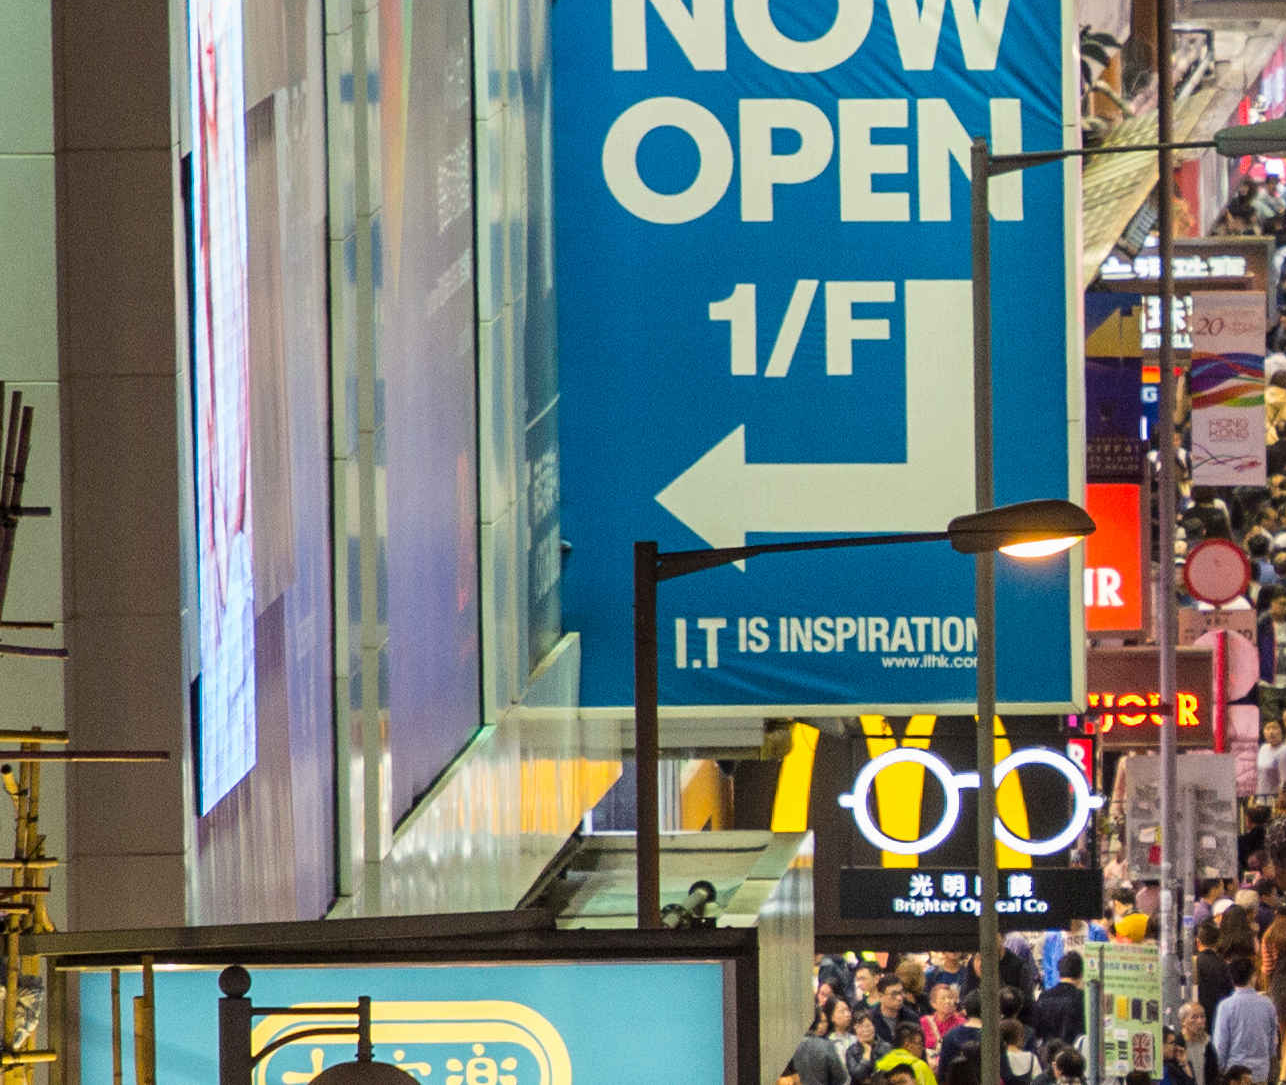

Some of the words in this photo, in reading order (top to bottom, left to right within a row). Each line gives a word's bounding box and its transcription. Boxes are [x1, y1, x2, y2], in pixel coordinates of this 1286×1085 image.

[602, 96, 1024, 225] OPEN
[708, 279, 896, 378] 1/F
[738, 616, 769, 653] IS
[909, 874, 1033, 898] 光明鏡
[893, 898, 958, 917] Brighter
[959, 898, 1020, 916] Opcal
[1023, 898, 1048, 914] Co
